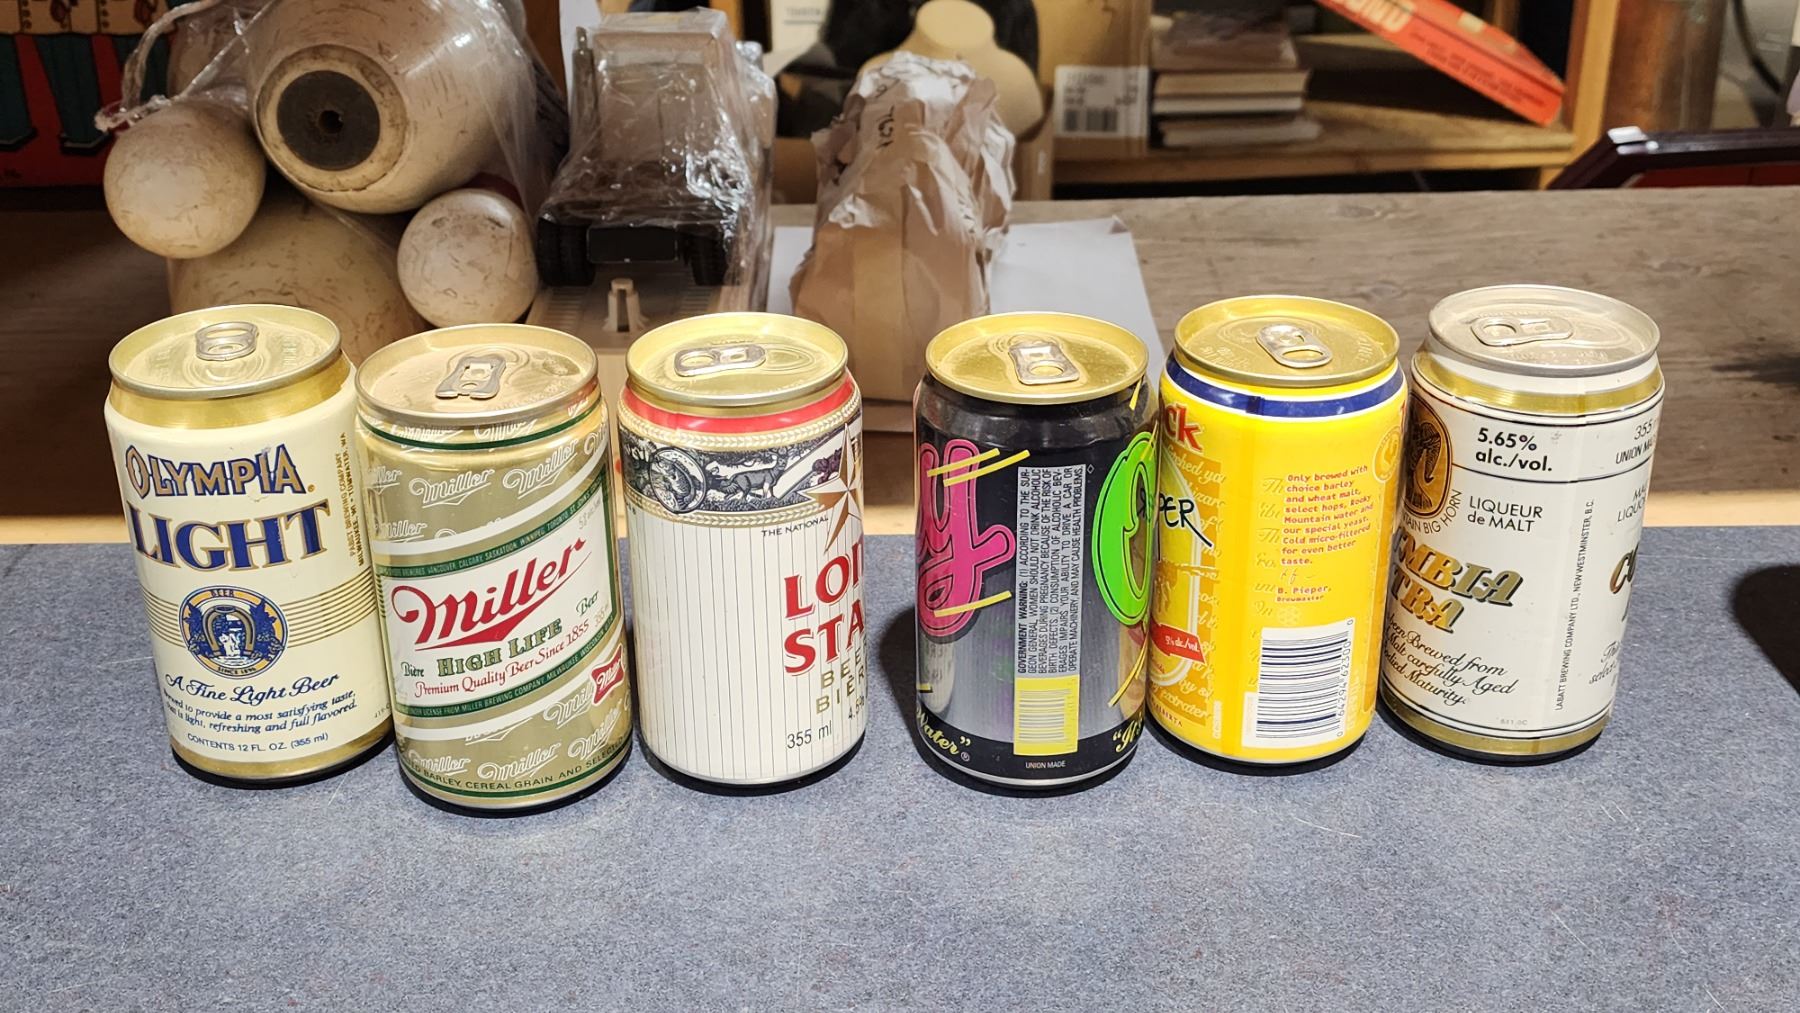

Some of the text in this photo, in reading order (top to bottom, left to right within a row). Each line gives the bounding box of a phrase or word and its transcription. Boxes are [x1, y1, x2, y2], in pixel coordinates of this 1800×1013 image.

[1476, 426, 1538, 452] 5.65%
[125, 443, 307, 499] OLYMPIA
[502, 438, 580, 496] Miller
[1474, 443, 1642, 473] alc./vol. UNION
[335, 453, 346, 491] COMPANY
[1021, 469, 1029, 487] SUR-
[1064, 468, 1072, 478] OR
[1287, 464, 1368, 483] Only brewed with
[408, 468, 495, 506] Miller
[1021, 491, 1029, 505] THE
[1063, 483, 1072, 498] CAR
[1286, 480, 1355, 493] choice barley
[1286, 495, 1304, 503] and
[1308, 492, 1336, 502] wheat
[341, 493, 351, 528] BREWING
[1021, 509, 1029, 518] TO
[1284, 515, 1331, 524] Mountain
[1334, 509, 1359, 520] water
[1285, 505, 1318, 514] select
[1423, 488, 1463, 534] BIG HORN
[1468, 495, 1544, 519] LIQUEUR
[126, 498, 331, 572] LIGHT
[761, 515, 829, 538] THE NATIONAL
[1062, 514, 1071, 536] DRIVE
[1072, 509, 1081, 536] HEALTH
[1282, 523, 1372, 545] Cold micro-filtered
[1283, 522, 1341, 535] our special
[1467, 510, 1536, 533] de MALT
[459, 556, 483, 568] CALGARY
[485, 542, 517, 561] SASKATOON
[520, 527, 546, 546] WINNIPEG
[1020, 523, 1029, 565] ACCORDING
[1062, 541, 1070, 549] TO
[1072, 537, 1080, 561] CAUSE
[1281, 540, 1357, 555] for even better
[1029, 469, 1040, 673] GEON WOMEN SHOULD NOT DRINK ALCOHOLIC
[1039, 469, 1051, 673] BEVERAGES DURING PREGNANCY BECAUSE OF THE RISK OF
[1048, 469, 1061, 673] BIRTH (2) CONSUMPTION OF ALCOHOLIC BEV-
[1061, 555, 1070, 582] ABILITY
[1071, 563, 1080, 579] MAY
[391, 537, 587, 645] Miller
[1019, 581, 1028, 619] WARNING:
[1060, 587, 1069, 606] YOUR
[1071, 581, 1079, 596] AND
[436, 647, 502, 677] HIGH
[508, 617, 563, 659] LIFE
[576, 589, 599, 618] Beer
[1059, 611, 1068, 640] IMPAIRS
[1018, 624, 1027, 673] GOVERNMENT
[1068, 641, 1077, 671] OPERATE
[1406, 630, 1510, 677] Brewed from
[1554, 575, 1583, 711] LABATT BREWING COMPANY NEW
[414, 619, 590, 698] Premium Quality Beer Since 1855
[1059, 646, 1067, 672] ERAGES
[444, 706, 460, 715] FROM
[462, 702, 483, 713] MILLER
[485, 691, 513, 707] BREWING
[514, 676, 545, 696] COMPANY
[546, 655, 579, 681] MILWAUKEE
[1406, 652, 1520, 696] carefully Aged
[165, 673, 340, 706] A Fine Light Beer
[195, 708, 232, 721] provide
[245, 712, 273, 721] most
[276, 700, 328, 719] satisfying
[209, 721, 261, 734] refreshing
[265, 720, 288, 732] and
[288, 714, 310, 731] full
[187, 732, 235, 751] CONTENTS
[237, 744, 249, 752] 12
[290, 737, 312, 750] (355
[568, 698, 622, 760] Miller
[787, 720, 832, 750] 355 ml
[477, 742, 562, 781] Miller
[1025, 760, 1067, 769] UNION MADE
[465, 765, 583, 790] CEREAL GRAIN AND
